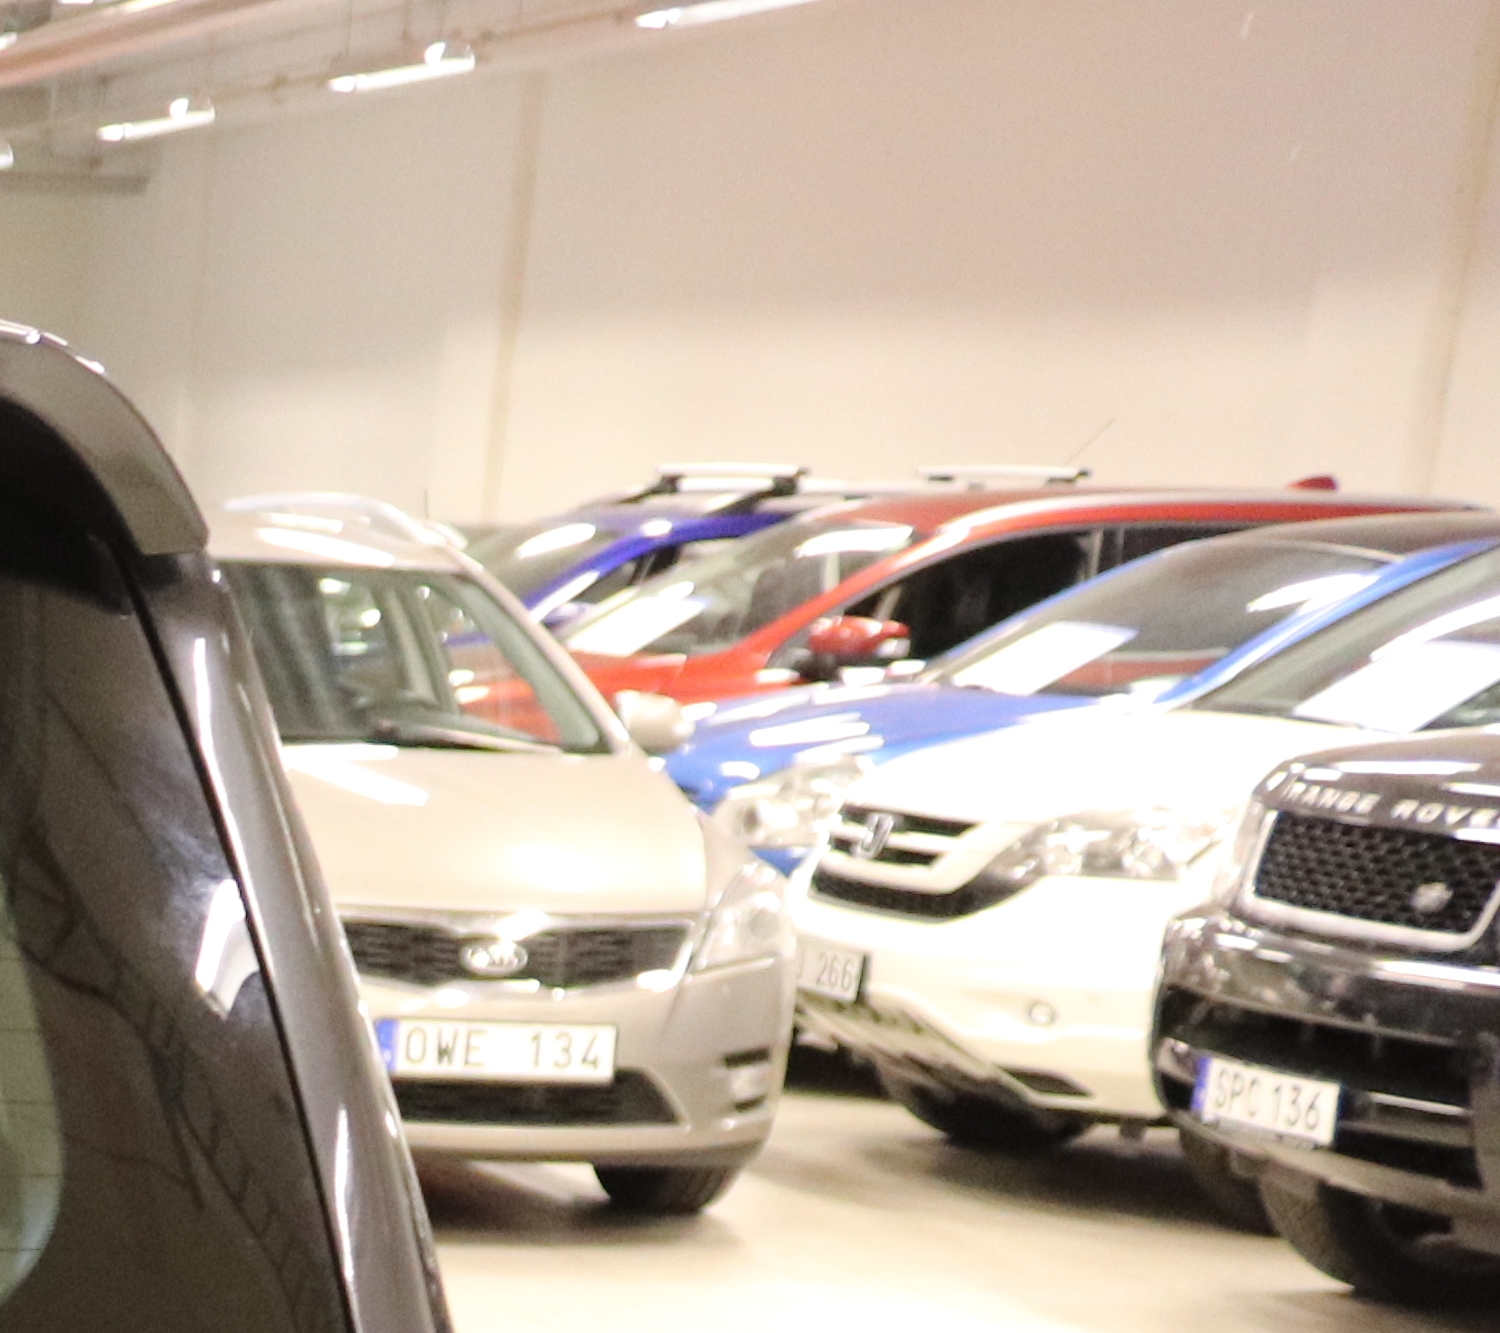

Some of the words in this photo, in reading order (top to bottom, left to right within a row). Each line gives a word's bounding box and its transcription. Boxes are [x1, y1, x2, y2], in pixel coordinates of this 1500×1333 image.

[1285, 782, 1381, 813] RANGE
[1391, 799, 1500, 828] ROVE
[405, 1027, 487, 1066] OWE
[531, 1030, 600, 1070] 134
[1273, 1083, 1321, 1130] 136
